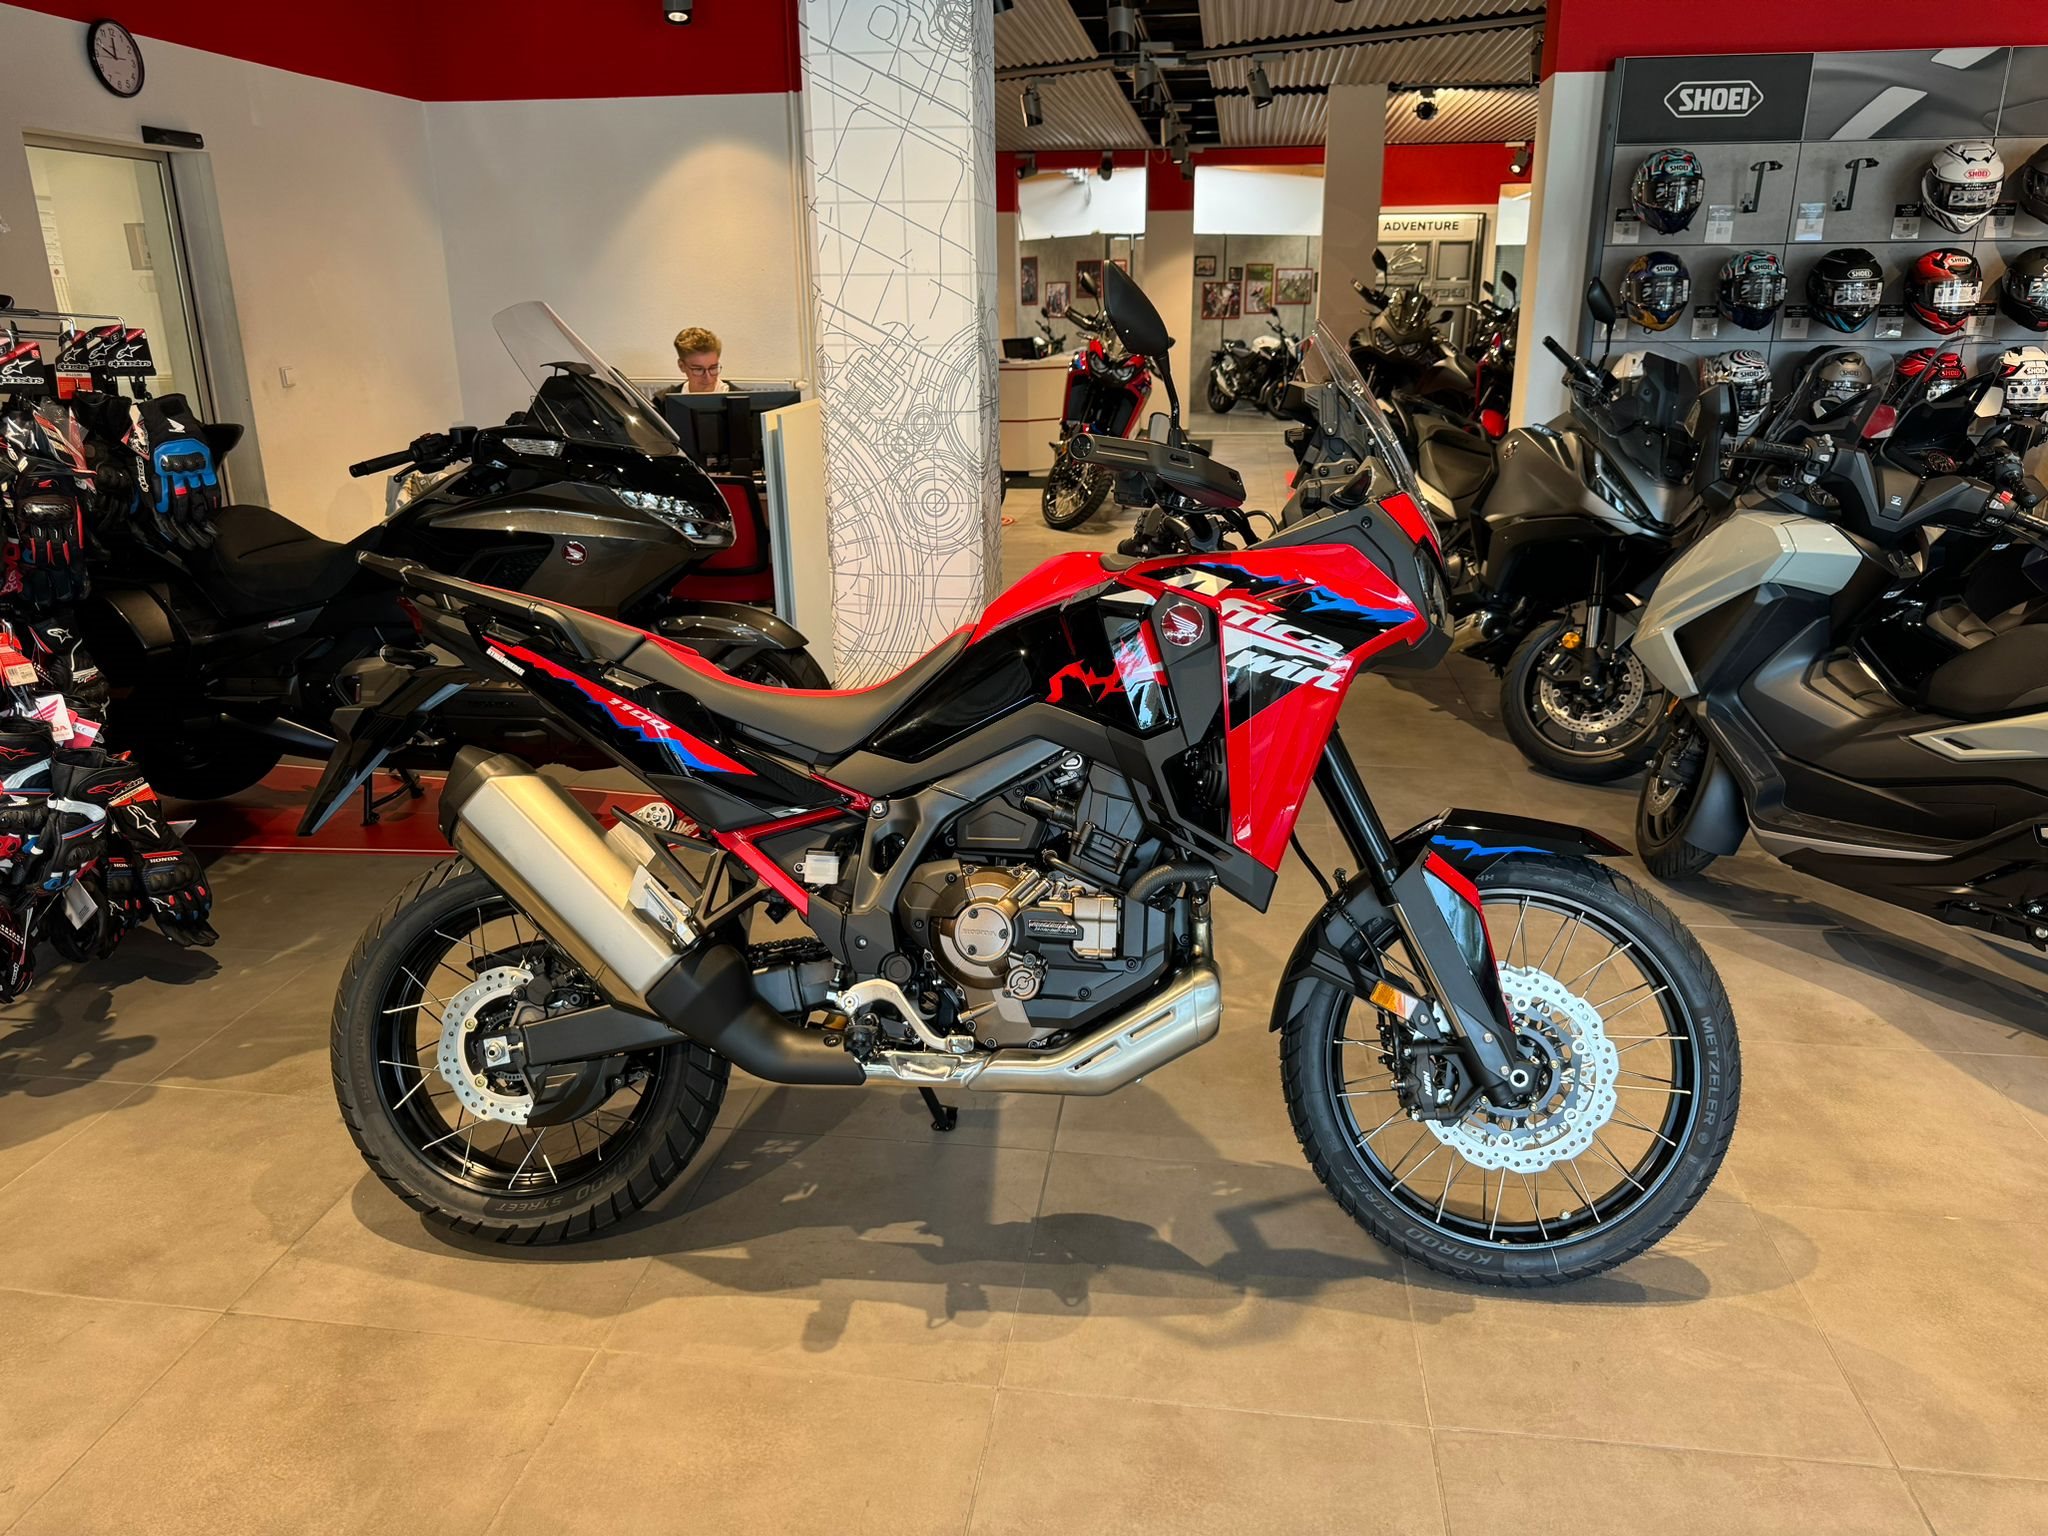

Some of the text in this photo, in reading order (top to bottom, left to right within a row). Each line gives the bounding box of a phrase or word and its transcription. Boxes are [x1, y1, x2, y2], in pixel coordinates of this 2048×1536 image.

[1678, 87, 1751, 111] SHOEI
[1967, 170, 1988, 178] SHOEI
[1383, 220, 1460, 231] ADVENTURE
[1851, 270, 1872, 278] SHOEI
[1700, 1015, 1721, 1127] METZELER
[495, 1196, 564, 1212] STREET
[1343, 1165, 1493, 1266] KAROO STREET
